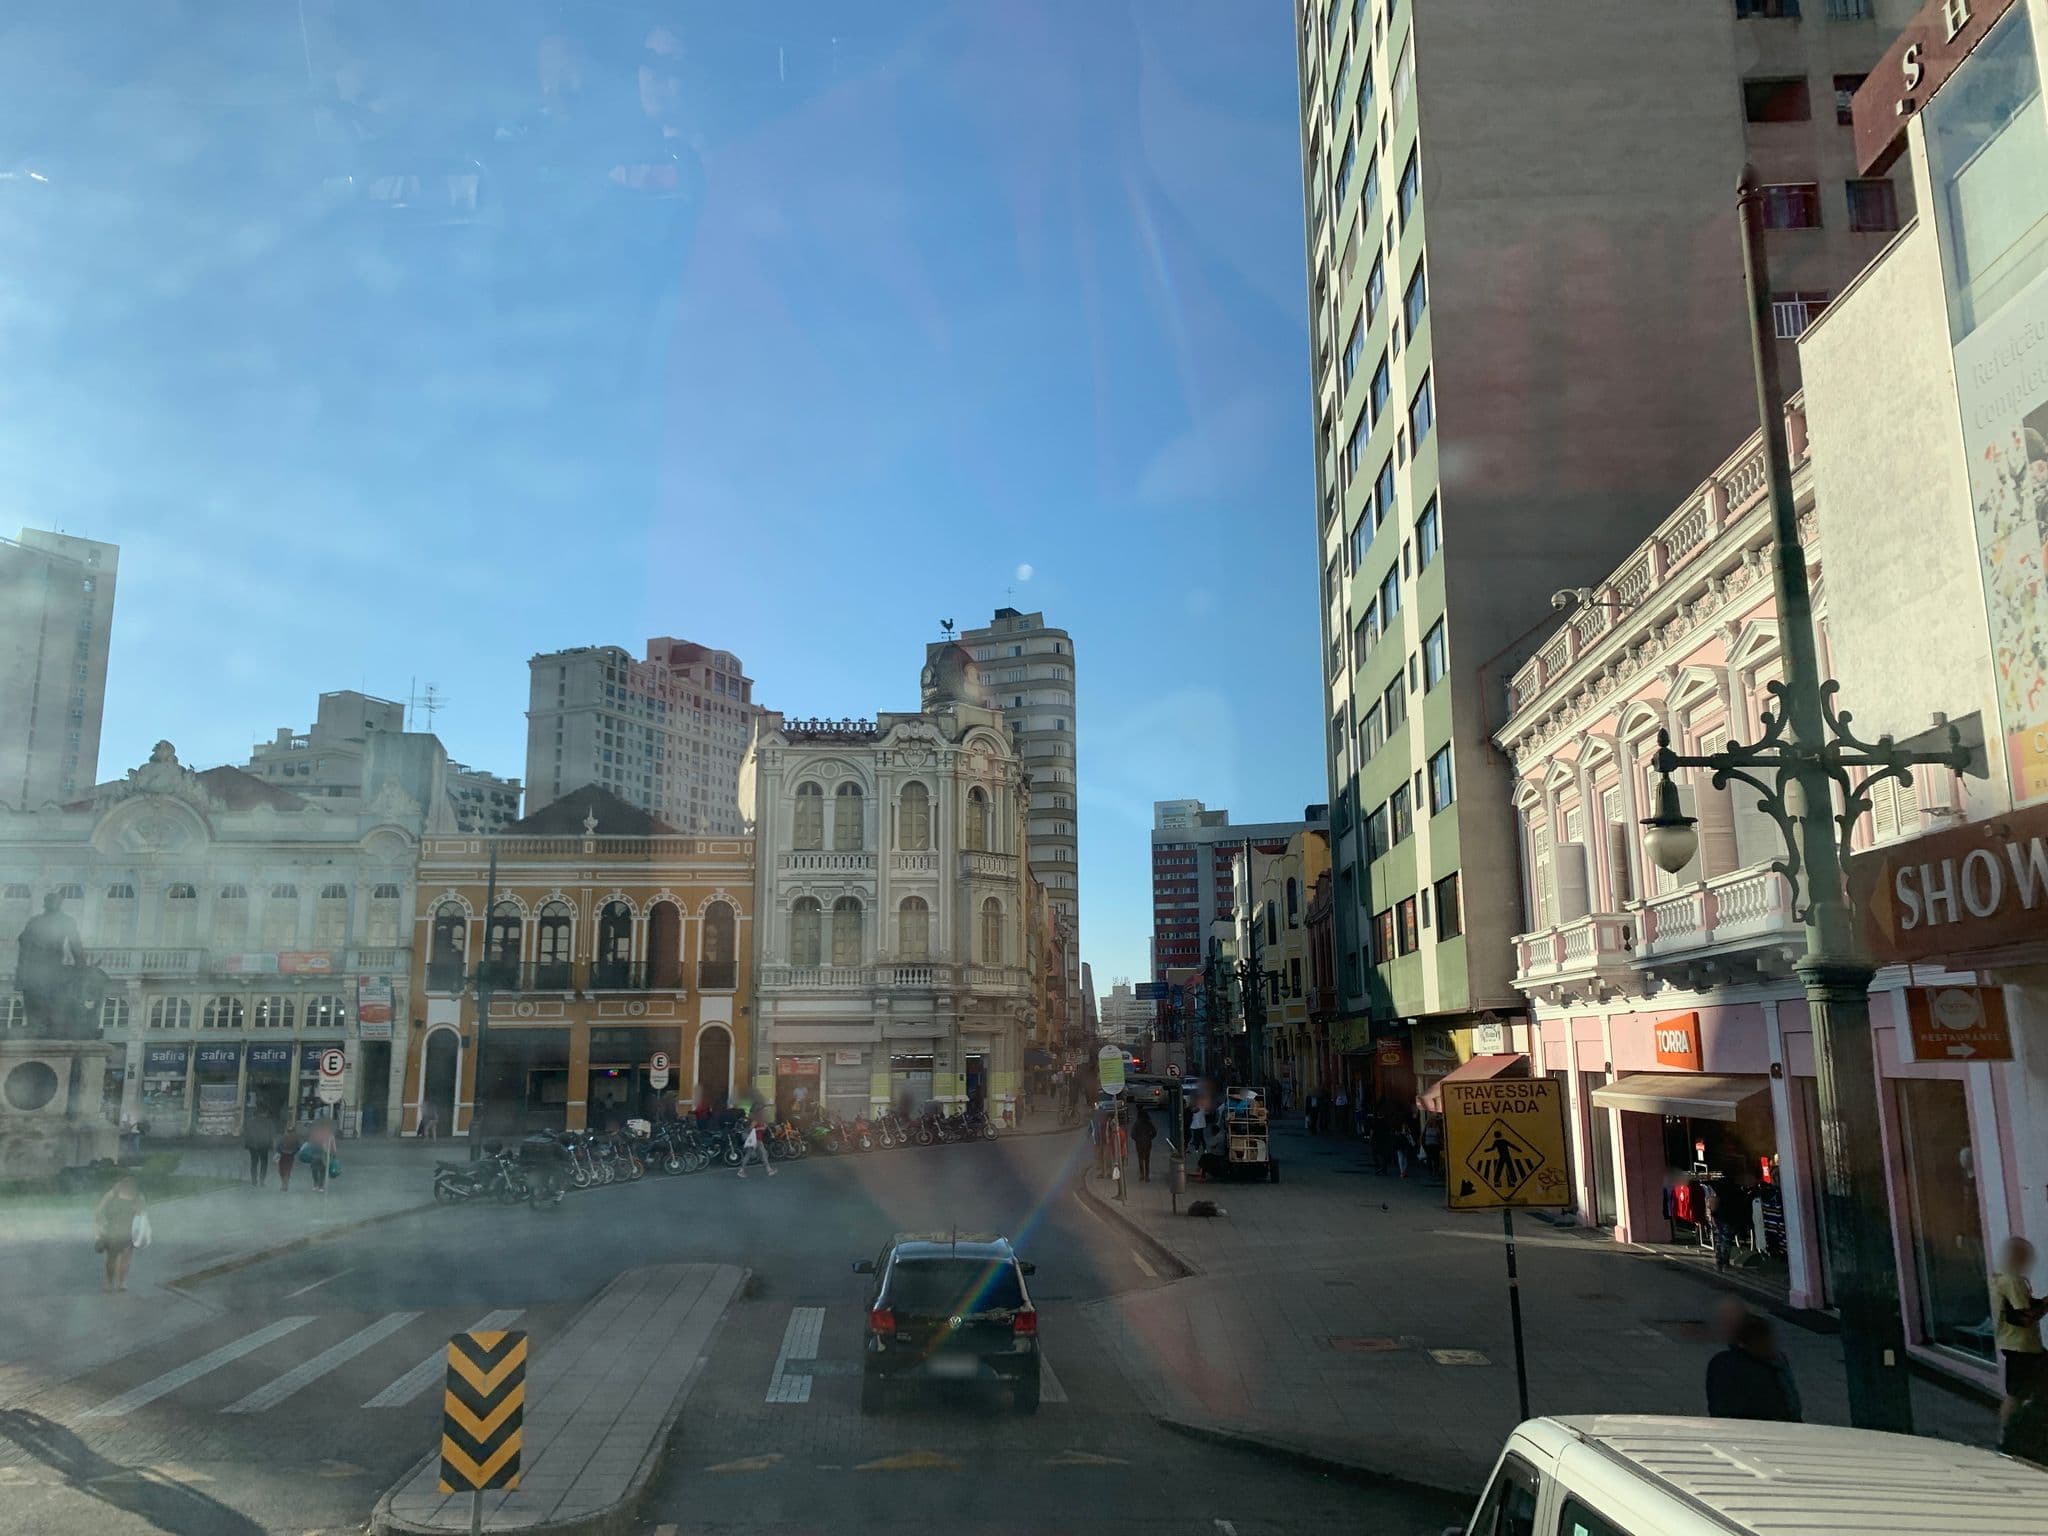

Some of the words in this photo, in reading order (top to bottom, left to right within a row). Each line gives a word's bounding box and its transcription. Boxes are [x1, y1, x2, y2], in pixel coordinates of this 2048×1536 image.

[1656, 1030, 1689, 1053] TORRA
[1920, 1031, 2001, 1042] RESTAURANTE
[151, 1050, 185, 1061] safira
[201, 1050, 235, 1061] safira
[253, 1049, 287, 1060] safira
[328, 1055, 338, 1070] E
[657, 1056, 664, 1067] E
[1454, 1084, 1548, 1101] TRAVESSIA
[1463, 1100, 1539, 1116] ELEVADA
